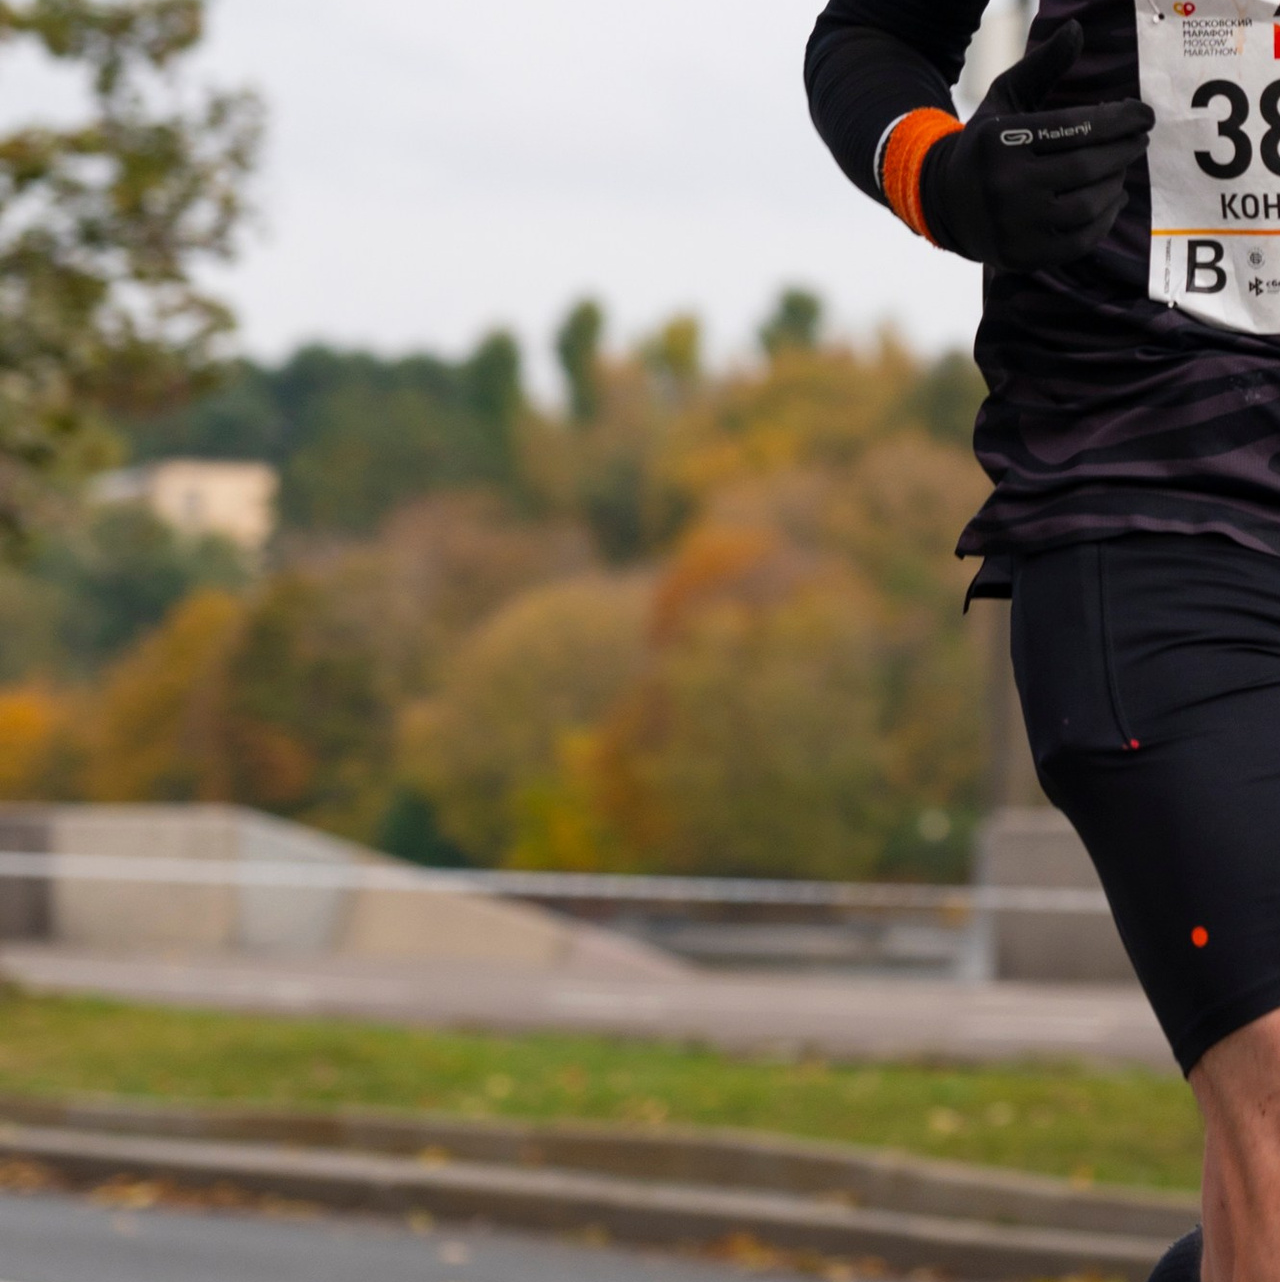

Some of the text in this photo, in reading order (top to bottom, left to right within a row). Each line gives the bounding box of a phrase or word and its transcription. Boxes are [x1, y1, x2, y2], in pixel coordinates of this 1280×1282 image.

[1182, 17, 1253, 28] МОСКОВСКИЙ
[1183, 28, 1233, 38] МАРАФОН
[1183, 38, 1228, 48] MOSCOW
[1184, 47, 1238, 57] MARATHON
[1038, 121, 1092, 140] Kalenji
[1185, 239, 1228, 294] B
